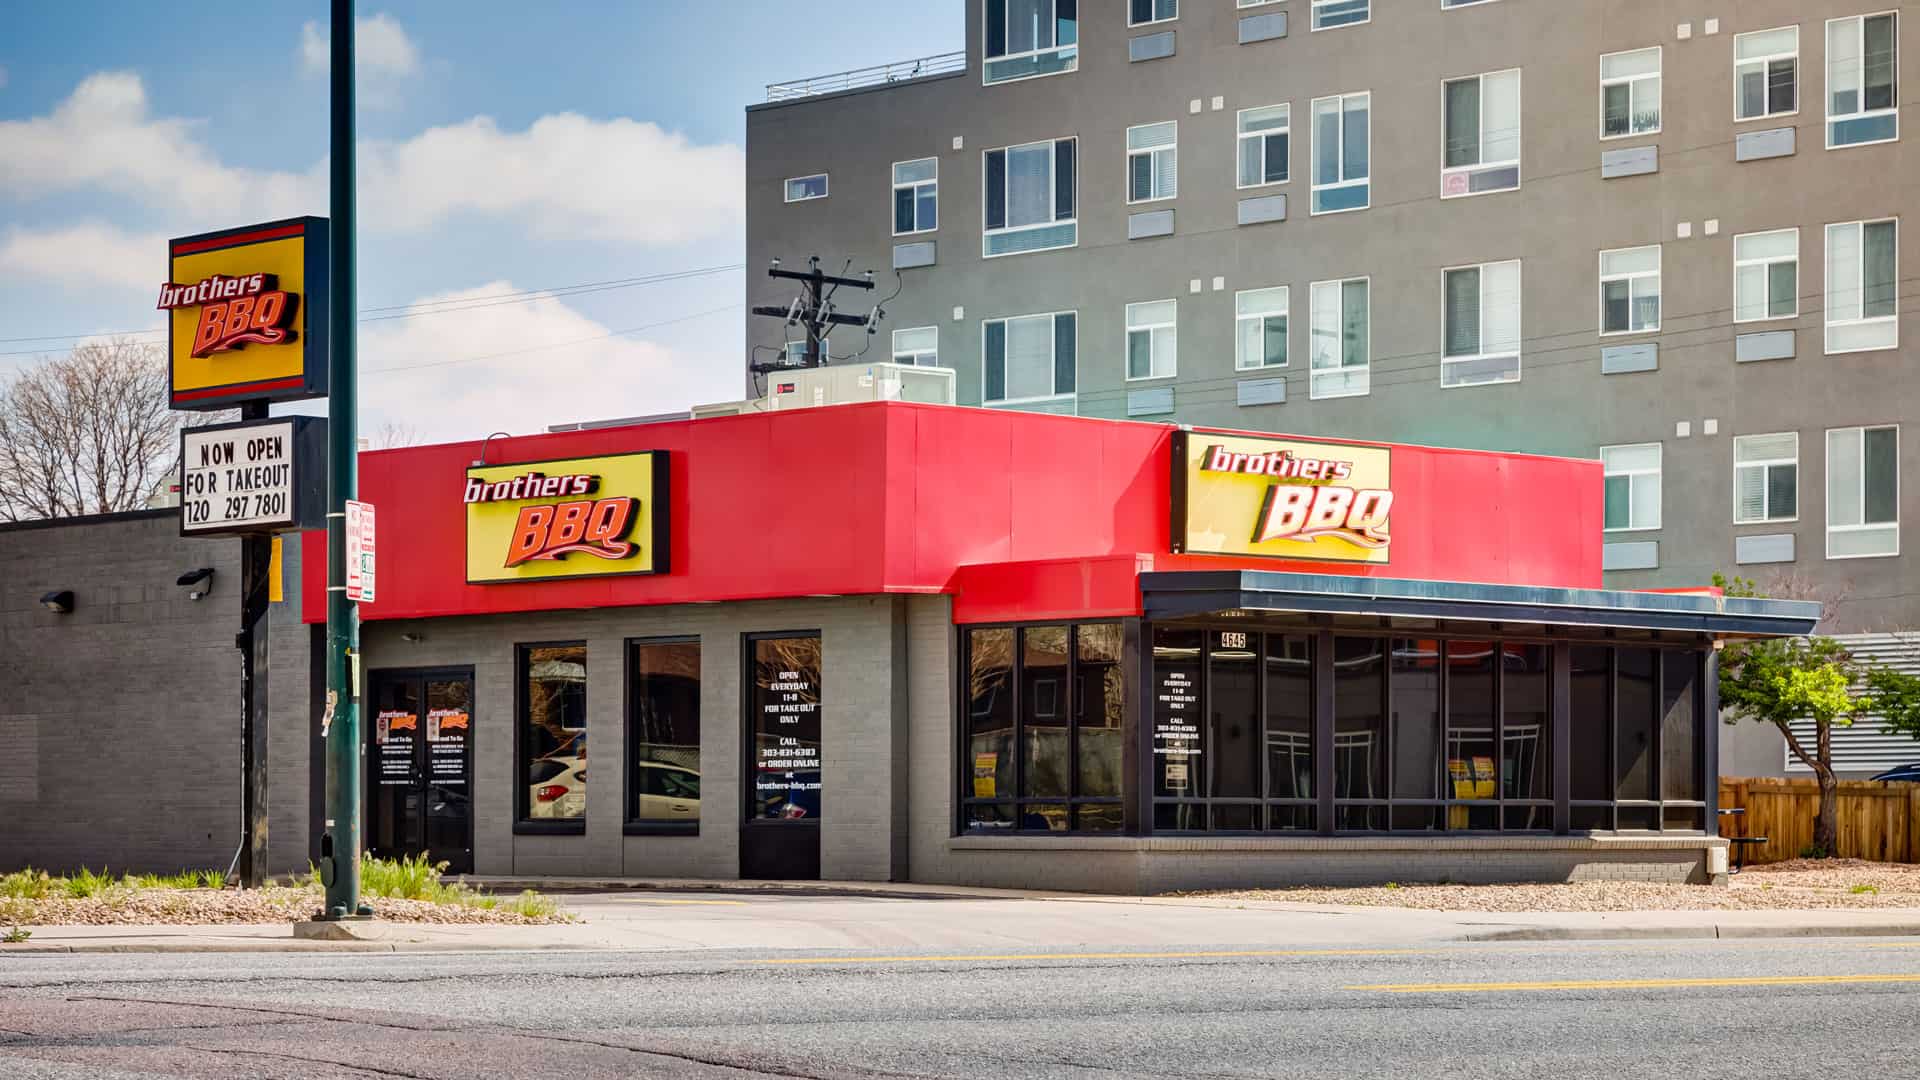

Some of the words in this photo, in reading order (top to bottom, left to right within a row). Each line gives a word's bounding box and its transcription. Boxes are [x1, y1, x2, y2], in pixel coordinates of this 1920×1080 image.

[158, 273, 264, 309] brothers
[191, 290, 287, 358] BBQ
[201, 441, 234, 466] NOW
[247, 436, 283, 461] OPEN
[1204, 446, 1354, 480] brothers
[186, 471, 217, 496] FOR
[226, 463, 289, 492] TAKEOUT
[463, 472, 594, 503] brothers
[185, 500, 210, 523] 720
[225, 496, 249, 519] 297
[255, 492, 286, 516] 7801
[1256, 484, 1394, 549] BBQ
[504, 496, 632, 568] BBQ
[1221, 632, 1246, 648] 4645
[771, 682, 809, 691] EVERYDAY
[779, 671, 799, 680] OPEN
[764, 704, 779, 713] FOR
[780, 715, 799, 724] ONLY
[780, 737, 798, 746] CALL
[768, 759, 792, 768] ORDER
[793, 759, 820, 768] ONLINE
[785, 771, 794, 779] at
